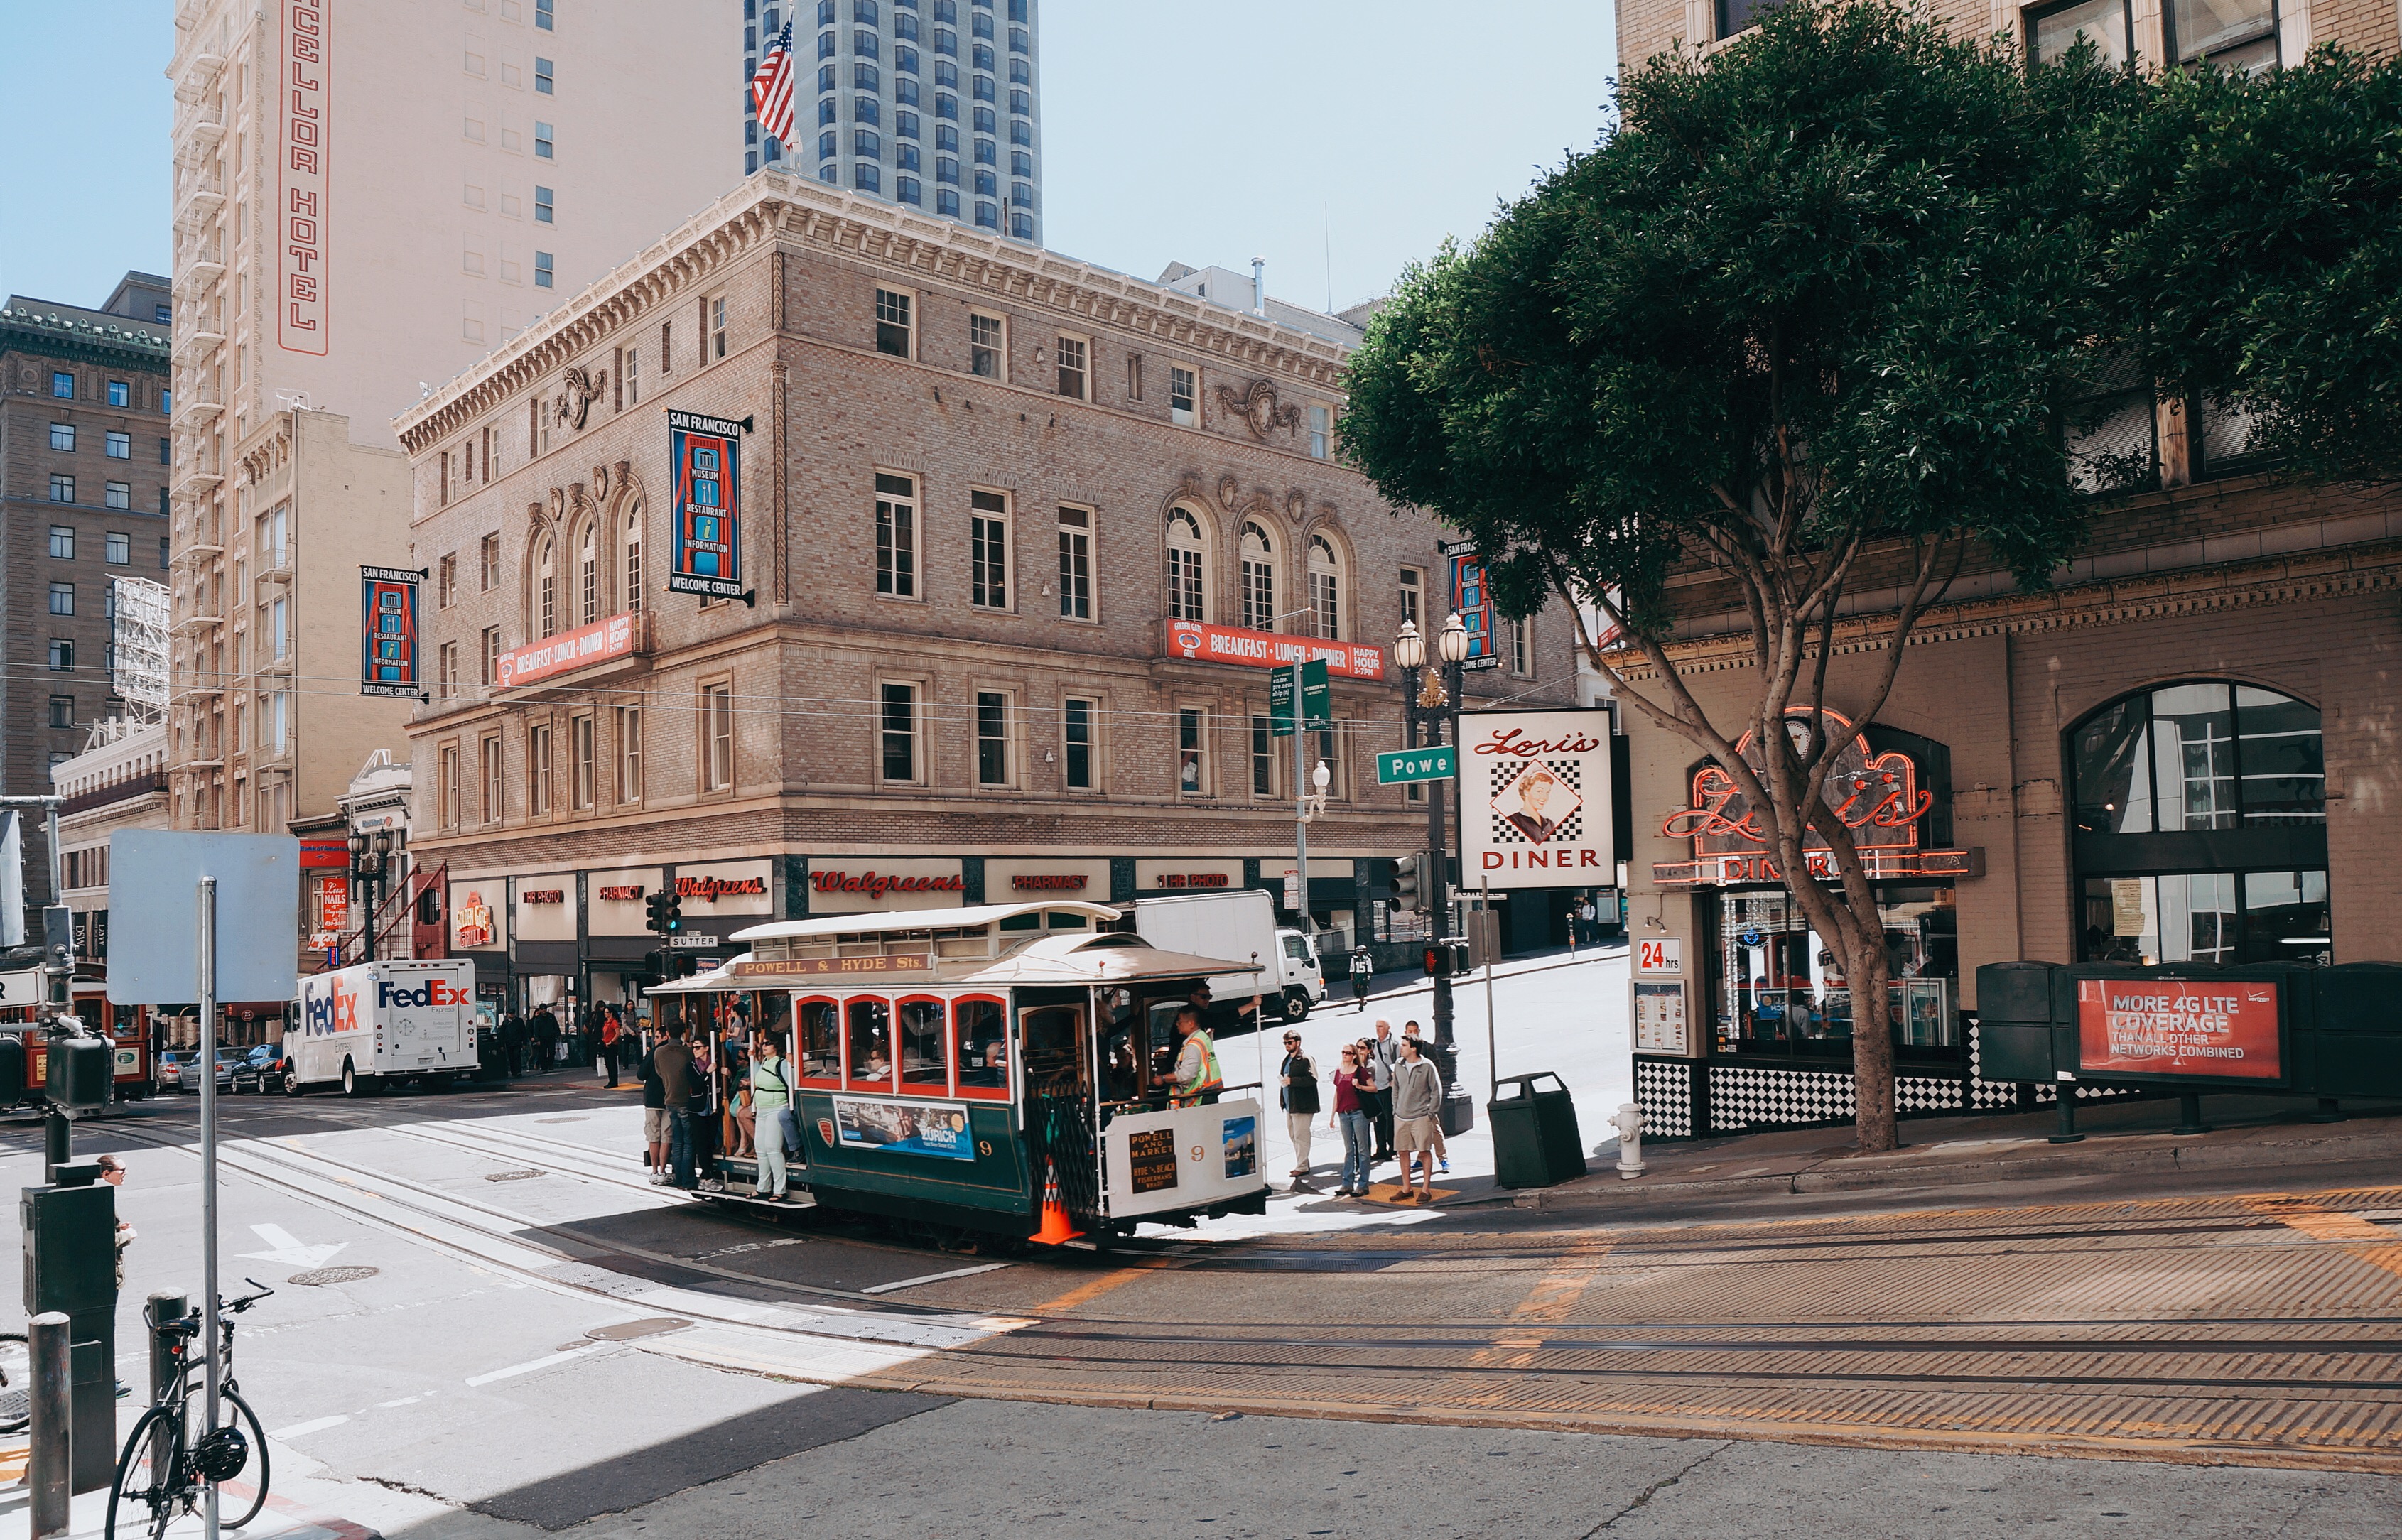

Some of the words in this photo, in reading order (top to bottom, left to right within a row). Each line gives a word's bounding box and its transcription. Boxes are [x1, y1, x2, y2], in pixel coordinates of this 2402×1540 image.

[291, 0, 319, 174] CELLOR
[289, 188, 318, 331] HOTEL
[671, 412, 690, 428] SAN
[691, 416, 738, 437] FRANCISCO
[691, 468, 718, 480] MUSEUM
[686, 504, 727, 518] RESTAURANT
[685, 539, 728, 553] INFORMATION
[1448, 544, 1460, 555] SAN
[363, 568, 378, 578] SAN
[379, 569, 418, 582] FRANCISCO
[672, 576, 710, 592] WELCOME
[712, 582, 740, 596] CENTER
[1461, 579, 1479, 588] MUSEUM
[379, 607, 401, 615] MUSEUM
[1459, 605, 1485, 615] RESTAURANT
[609, 616, 629, 631] HAPPY
[374, 632, 407, 641] RESTAURANT
[609, 628, 629, 644] HOUR
[517, 647, 551, 675] BREAKFAST
[555, 639, 575, 663] LUNCH
[580, 631, 603, 656] DINNER
[1183, 649, 1196, 658] GRILL
[1211, 634, 1267, 659] BREAKFAST
[1312, 647, 1346, 668] DINNER
[1353, 647, 1379, 658] HAPPY
[373, 658, 408, 666] INFORMATION
[1354, 657, 1380, 670] HOUR
[1478, 658, 1497, 667] CENTER
[363, 685, 394, 695] WELCOME
[395, 688, 418, 697] CENTER
[1474, 727, 1600, 757] Lori's
[1663, 773, 1933, 843] Loi's
[1483, 849, 1601, 870] DINER
[1724, 856, 1831, 881] DINR
[809, 871, 967, 899] Walgreens
[1012, 874, 1089, 889] PHARMACY
[1157, 874, 1164, 888] 1
[1167, 874, 1186, 887] HR
[1189, 874, 1229, 887] PHOTO
[526, 892, 536, 904] HR
[537, 890, 561, 904] PHOTO
[600, 885, 641, 900] PHARMACY
[675, 876, 767, 903] Walgreens
[325, 894, 346, 904] NAILS
[75, 926, 85, 946] DSW
[460, 928, 482, 948] GRILL
[1641, 942, 1664, 968] 24
[1666, 957, 1679, 969] hrs
[745, 962, 806, 974] POWELL
[818, 960, 828, 971] &
[841, 958, 887, 970] HYDE
[897, 958, 922, 968] Sts.
[379, 980, 470, 1008] FedEx
[305, 975, 358, 1036] FedEx
[2114, 995, 2170, 1012] MORE
[2173, 996, 2200, 1013] 4G
[2204, 997, 2239, 1014] LTE
[2112, 1013, 2229, 1033] COVERAGE
[2112, 1032, 2143, 1043] THAN
[2147, 1034, 2165, 1043] ALL
[2169, 1034, 2209, 1045] OTHER
[335, 1041, 352, 1053] Express
[2111, 1044, 2177, 1056] NETWORKS
[2179, 1046, 2244, 1058] COMBINED
[1132, 1132, 1172, 1144] POWELL
[979, 1140, 992, 1156] 9
[1132, 1145, 1173, 1159] MARKET
[1191, 1145, 1205, 1162] 9
[1133, 1166, 1148, 1176] HYDE
[1157, 1162, 1175, 1173] BEACH
